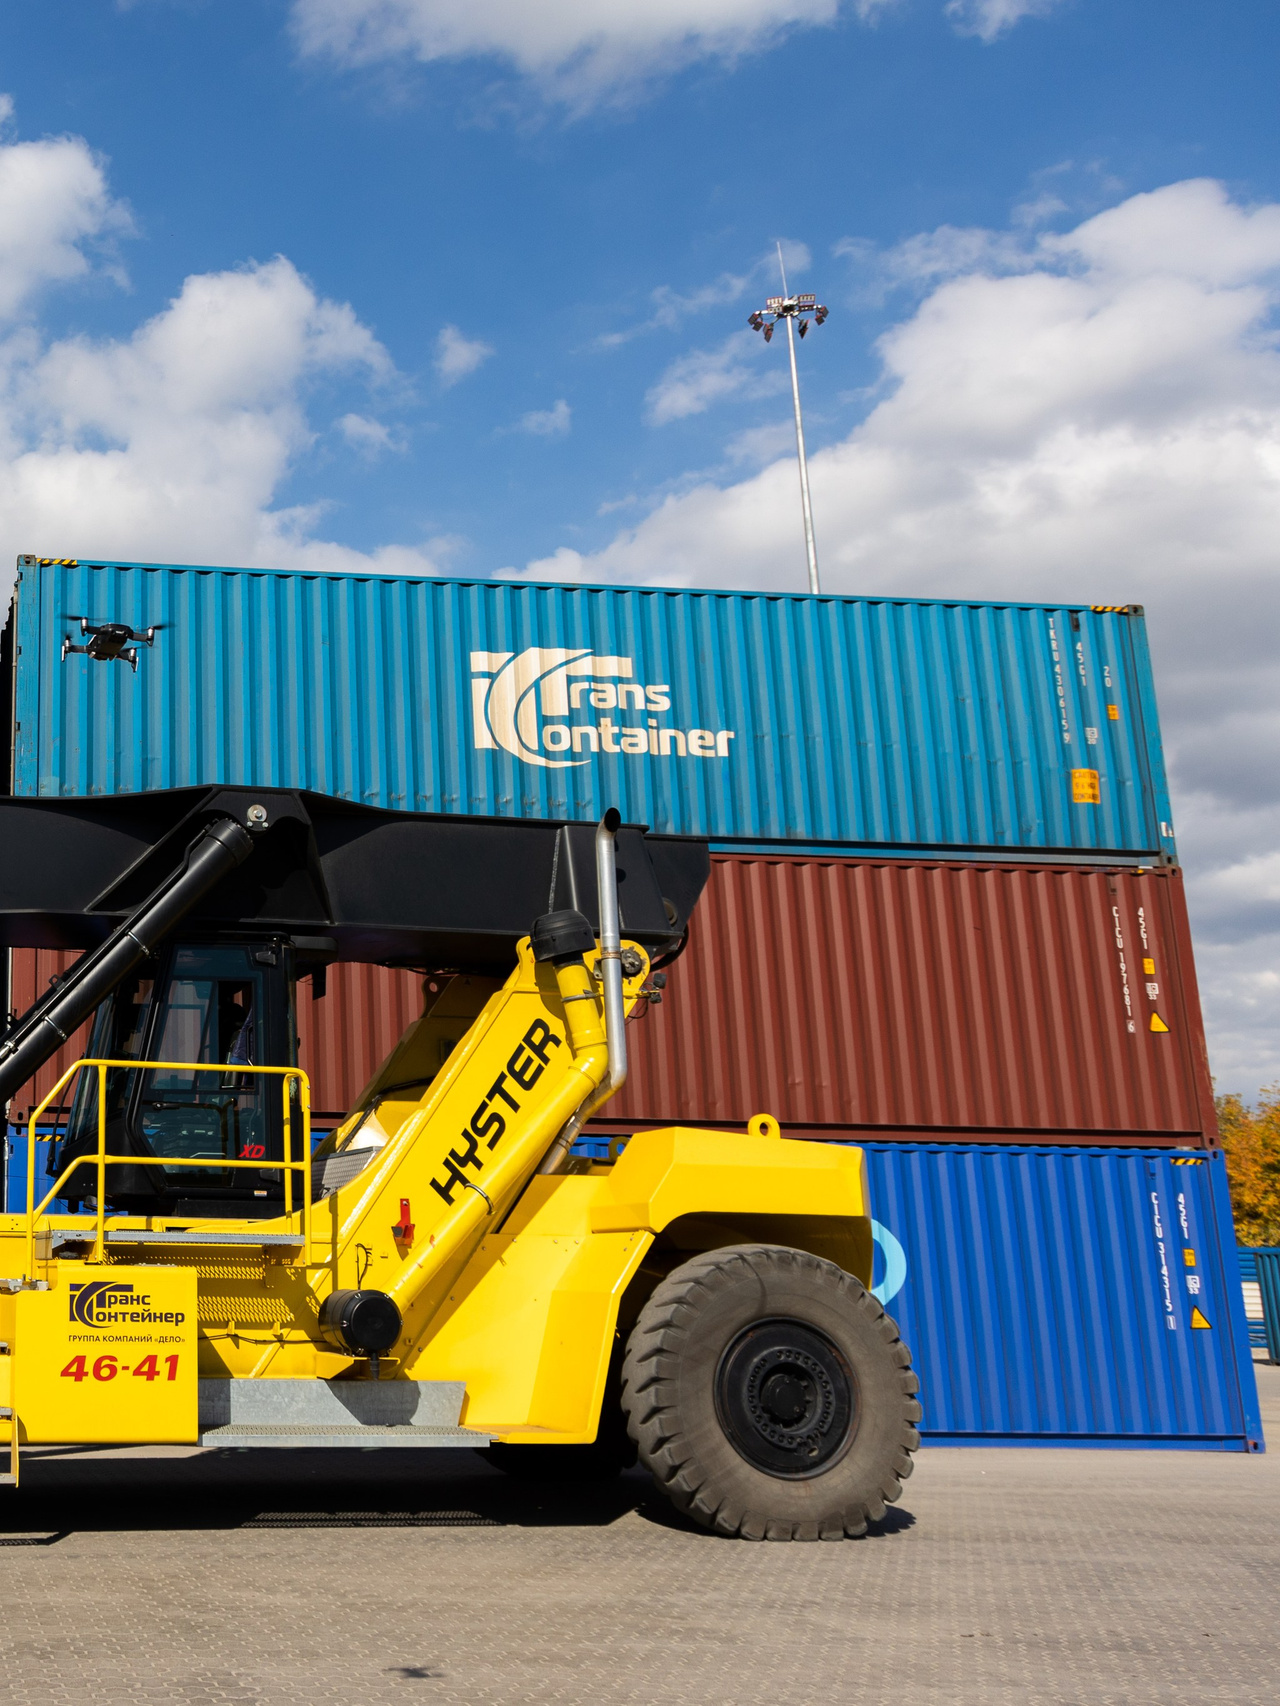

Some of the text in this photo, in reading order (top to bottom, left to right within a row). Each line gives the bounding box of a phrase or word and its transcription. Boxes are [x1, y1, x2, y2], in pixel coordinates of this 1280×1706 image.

[1075, 642, 1087, 686] 45G1
[1103, 666, 1112, 687] 20
[539, 655, 671, 716] Trans
[487, 647, 735, 768] Container
[1137, 907, 1148, 949] 45G1
[429, 1018, 562, 1206] HYSTER
[238, 1144, 265, 1158] XD
[1177, 1192, 1188, 1239] 45G1
[95, 1283, 151, 1309] Транс
[68, 1335, 100, 1343] ГРУППА
[103, 1333, 153, 1343] КОМПАНИЙ
[60, 1354, 179, 1382] 46-41
